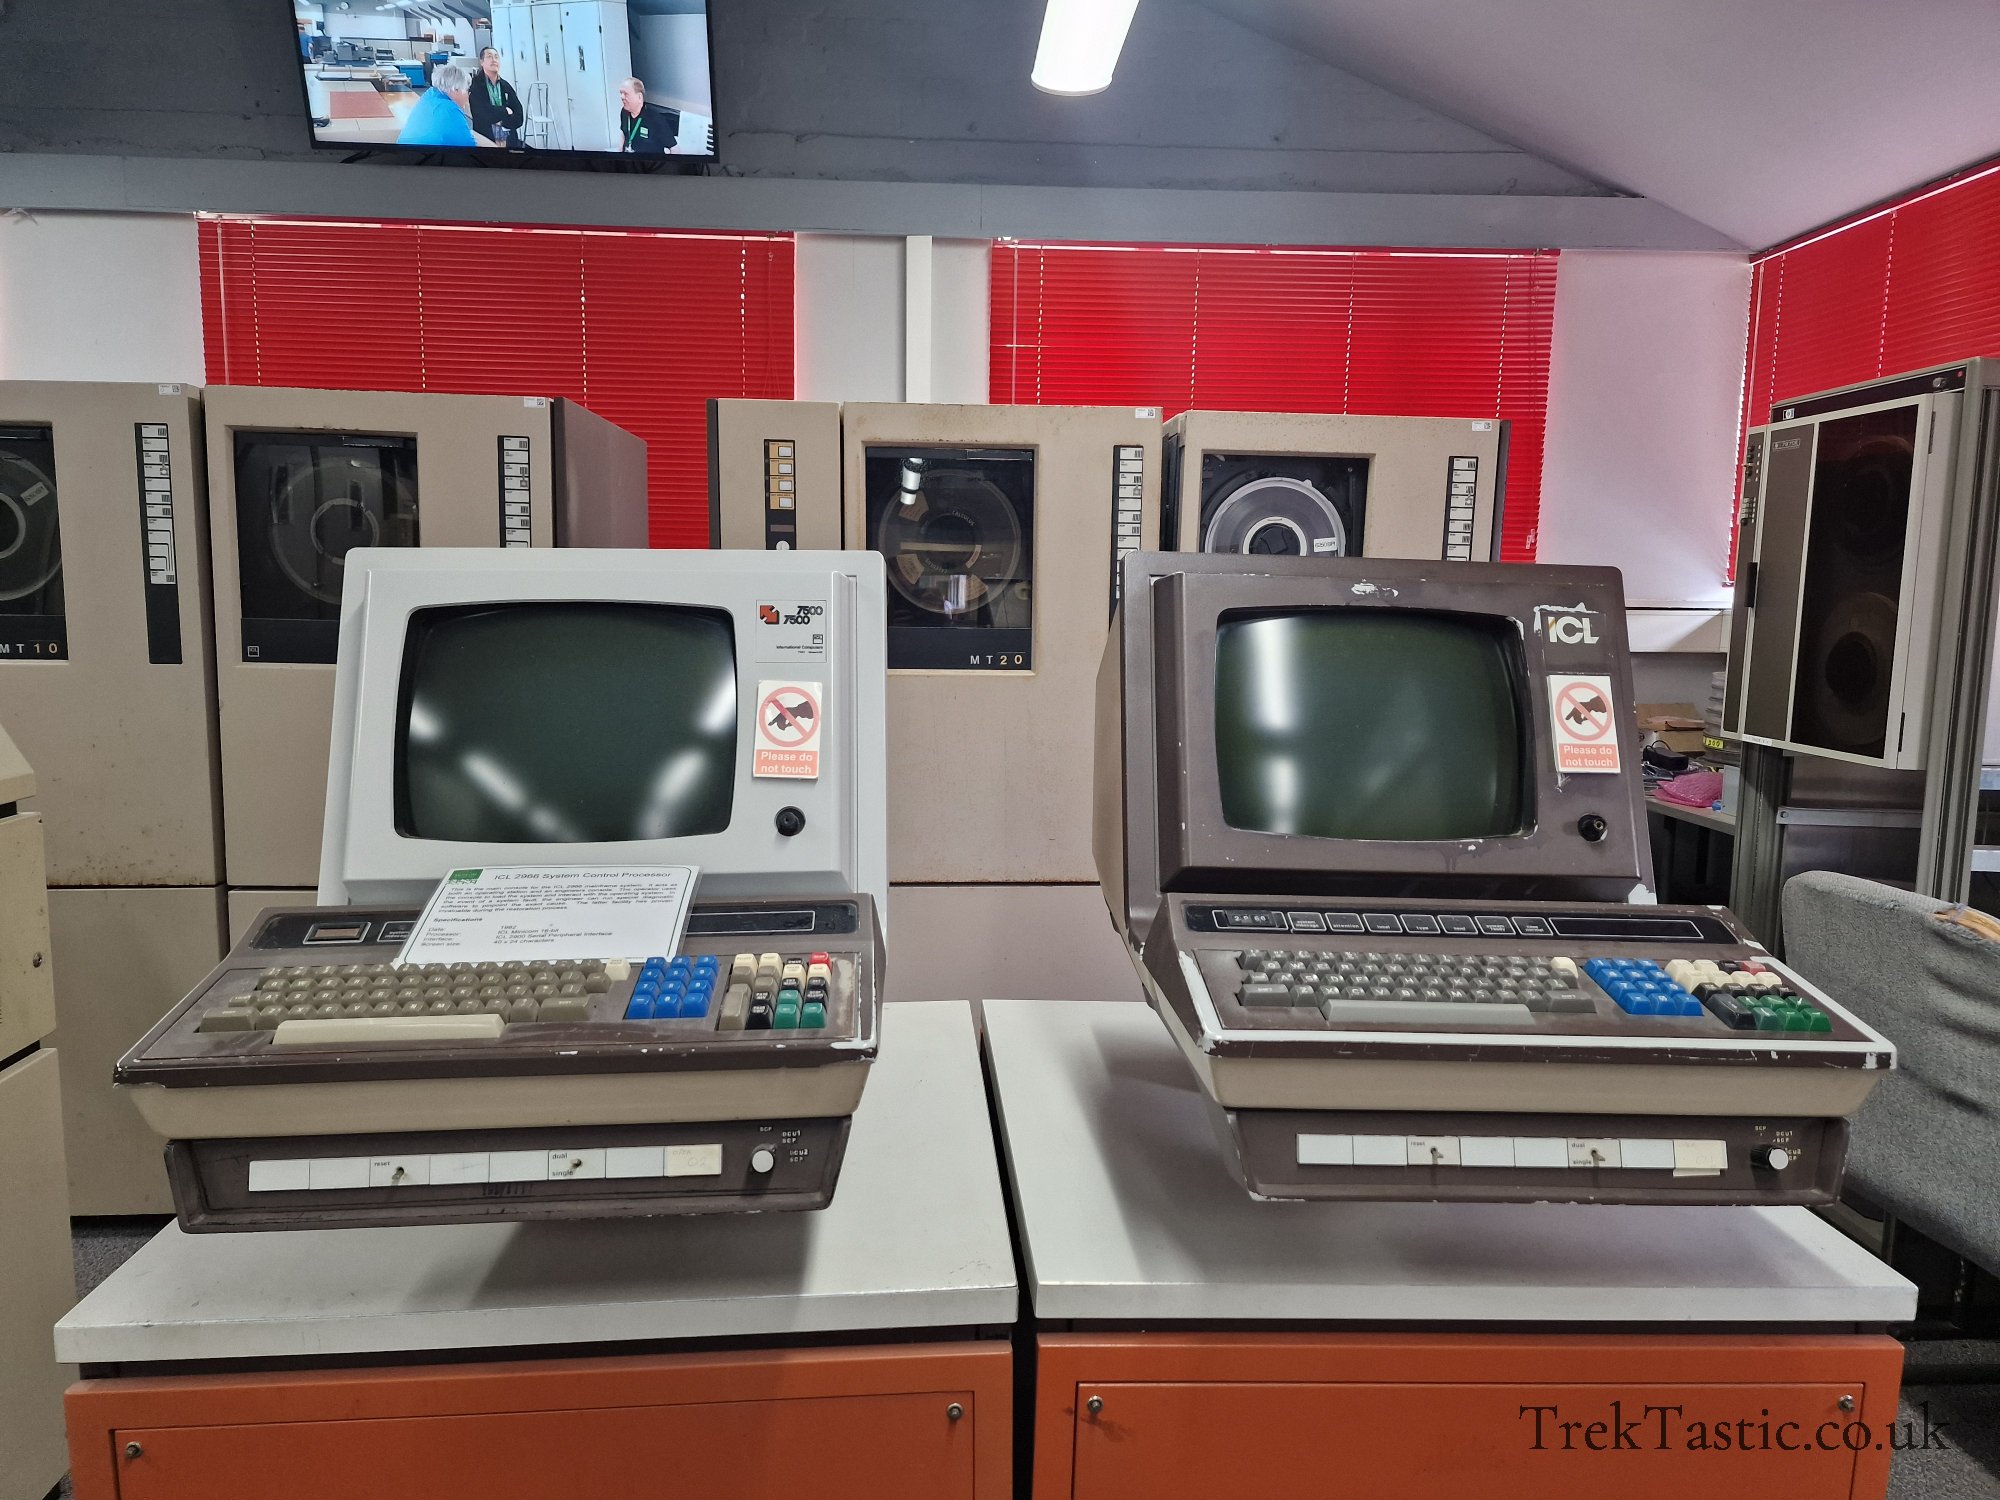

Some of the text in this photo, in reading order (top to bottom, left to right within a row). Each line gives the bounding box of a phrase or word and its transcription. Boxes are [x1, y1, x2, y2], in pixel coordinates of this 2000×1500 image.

[796, 606, 824, 615] 7500
[783, 615, 810, 625] 7500
[1548, 616, 1600, 644] ICL
[1564, 745, 1612, 755] Please do
[761, 752, 813, 762] Please do
[1566, 758, 1613, 767] not touch
[761, 765, 812, 774] not touch
